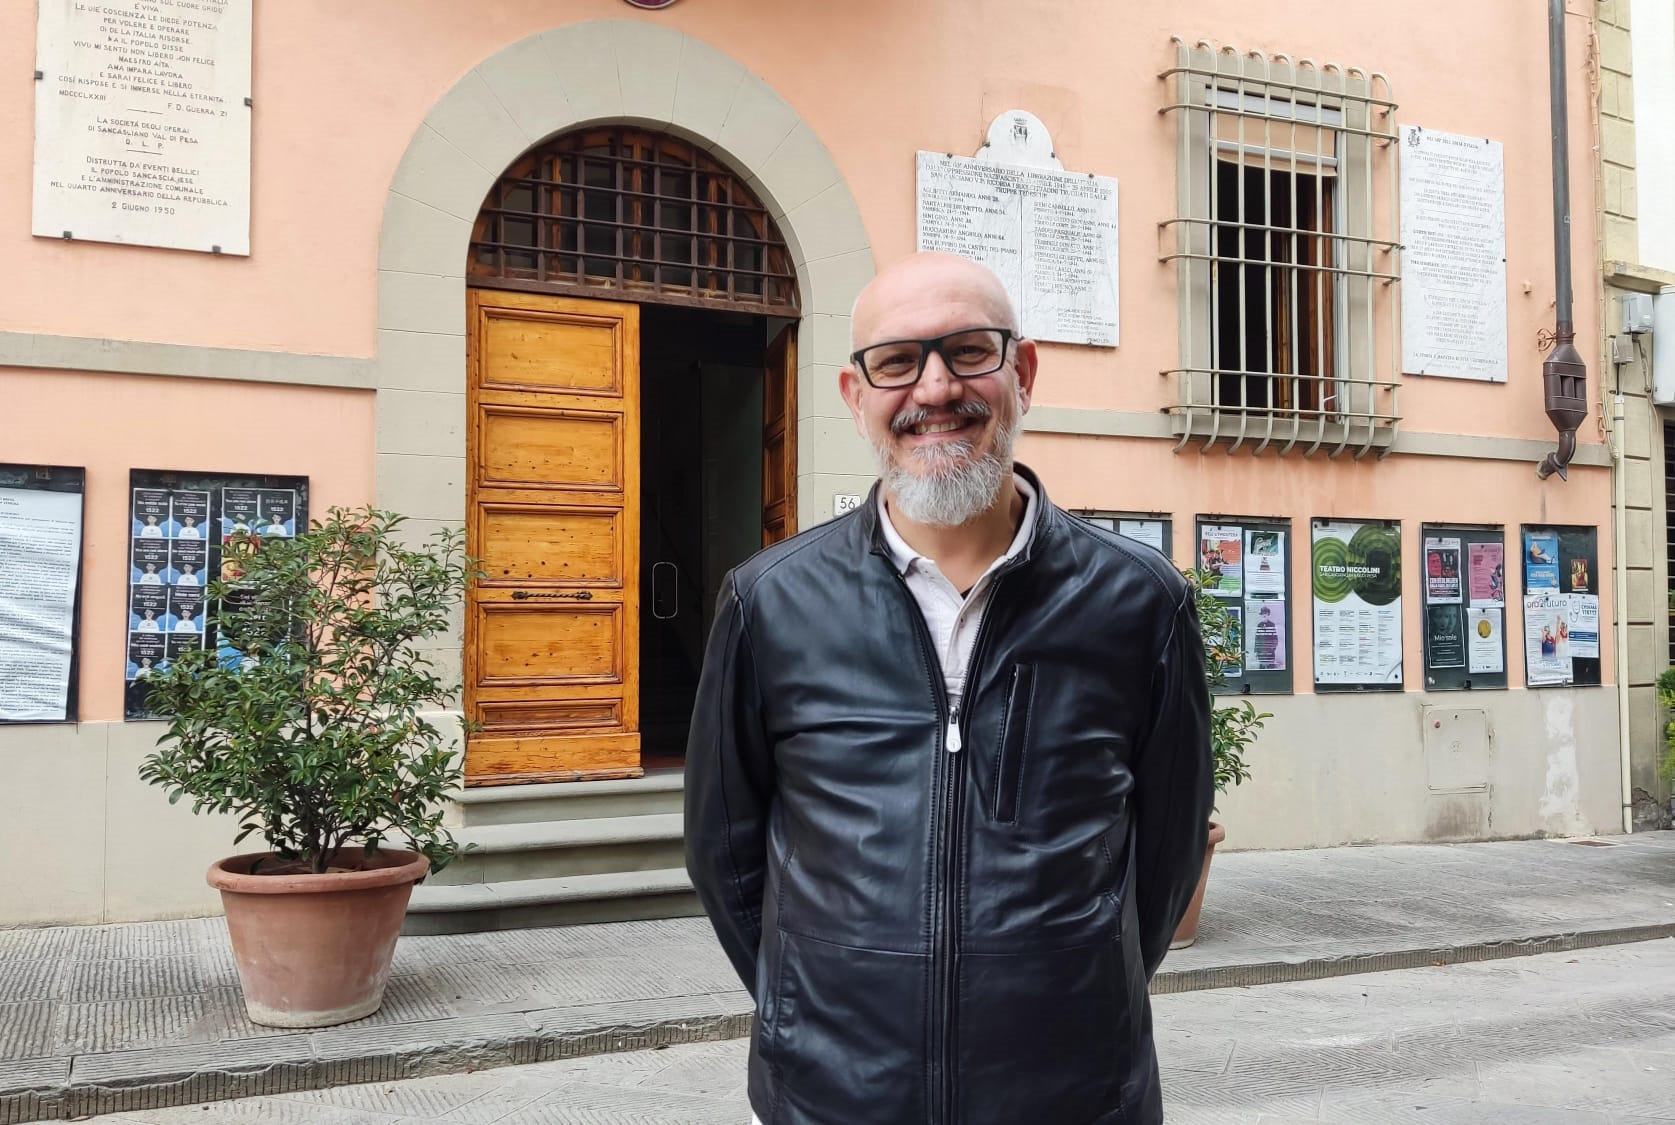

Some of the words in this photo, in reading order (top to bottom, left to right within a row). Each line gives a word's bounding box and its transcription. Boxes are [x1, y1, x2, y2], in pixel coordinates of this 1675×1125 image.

[119, 20, 148, 30] VOLERE
[132, 31, 156, 39] ITALIA
[130, 40, 158, 49] POPOLO
[148, 52, 174, 60] LIBERO
[192, 57, 216, 66] FELICE
[126, 66, 152, 75] IMPARA
[154, 69, 183, 79] LAVORA
[134, 76, 158, 85] FELICE
[168, 81, 193, 90] LIBERO
[164, 89, 188, 98] NELLA
[186, 104, 228, 118] GUERRAZI
[97, 116, 108, 124] LA
[152, 132, 166, 141] VAL
[180, 136, 199, 144] PESA
[86, 156, 127, 168] DISTRUTTA
[143, 164, 169, 173] EVENTI
[100, 168, 129, 177] POPOLO
[100, 186, 154, 198] ANNIVERSARIO
[156, 192, 181, 201] DELLA
[165, 185, 204, 195] COMUNALE
[154, 206, 176, 216] 1950
[840, 497, 856, 510] 56
[1347, 566, 1380, 574] NICCOLINI
